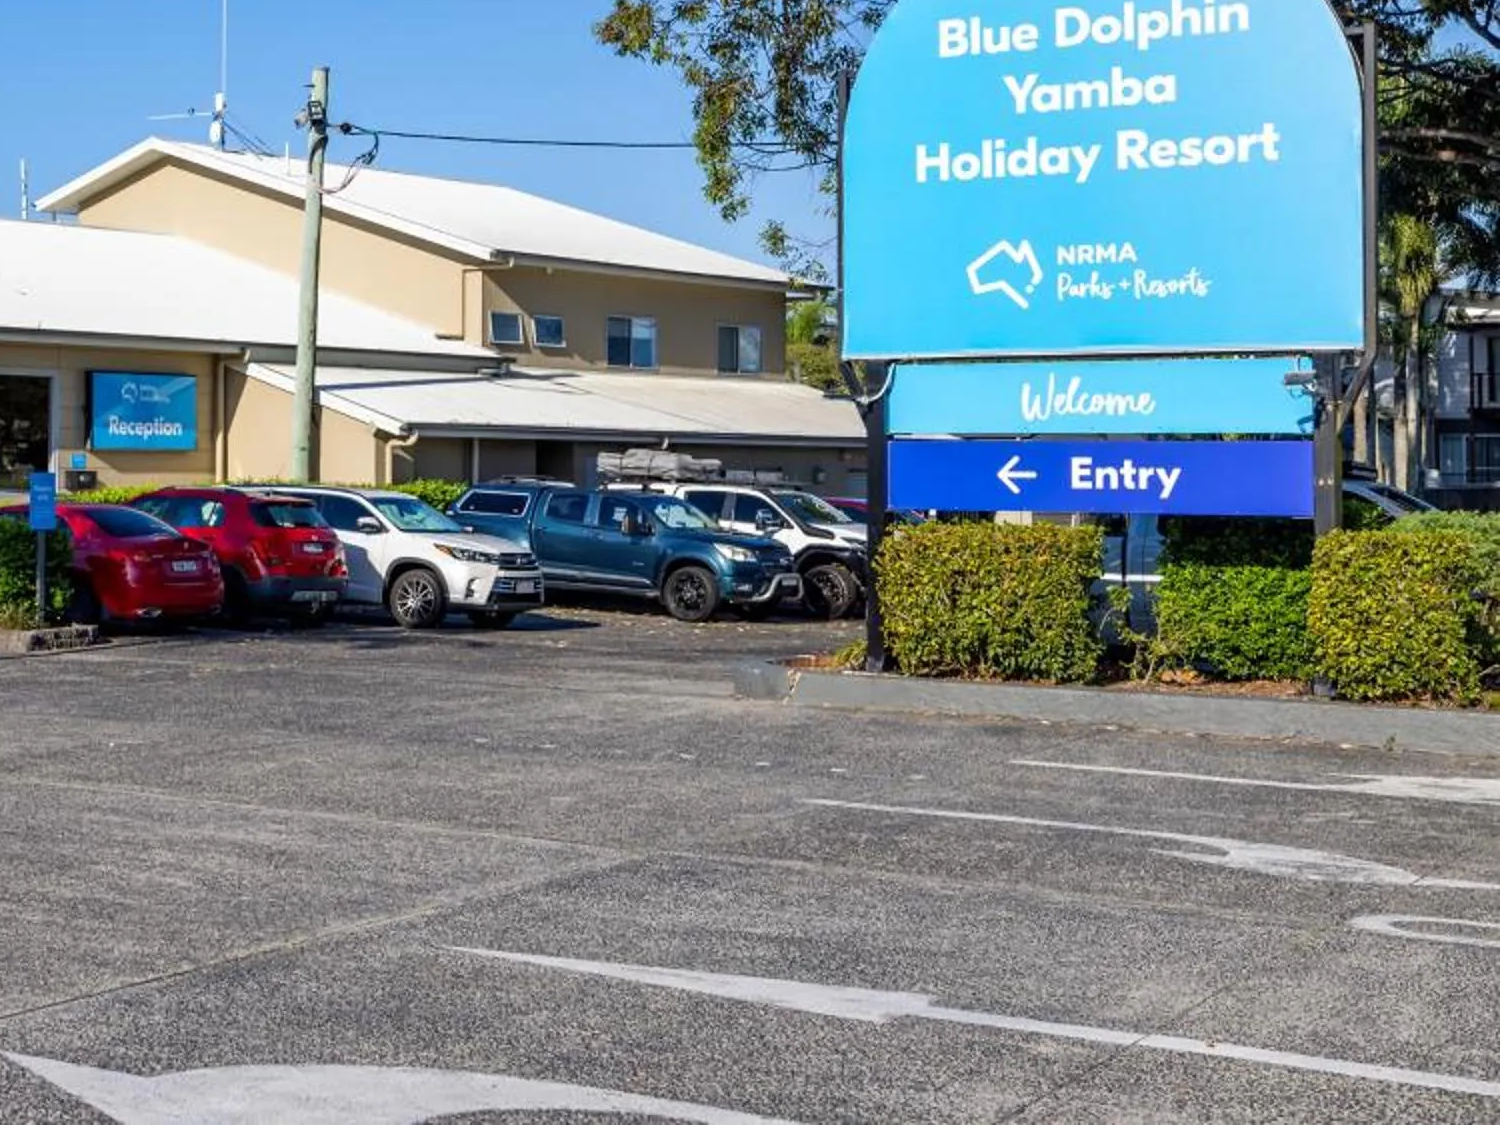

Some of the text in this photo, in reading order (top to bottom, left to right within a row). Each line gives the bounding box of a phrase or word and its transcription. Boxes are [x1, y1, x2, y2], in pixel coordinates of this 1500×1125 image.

[938, 16, 1039, 58] Blue
[1002, 66, 1177, 114] Yamba
[915, 122, 1281, 183] Holiday Resort
[1056, 242, 1138, 266] NRMA
[1056, 270, 1115, 301] Parks
[1133, 266, 1213, 300] Resorts
[1020, 372, 1157, 422] Welcome
[108, 414, 183, 441] Reception
[1070, 456, 1182, 500] Entry
